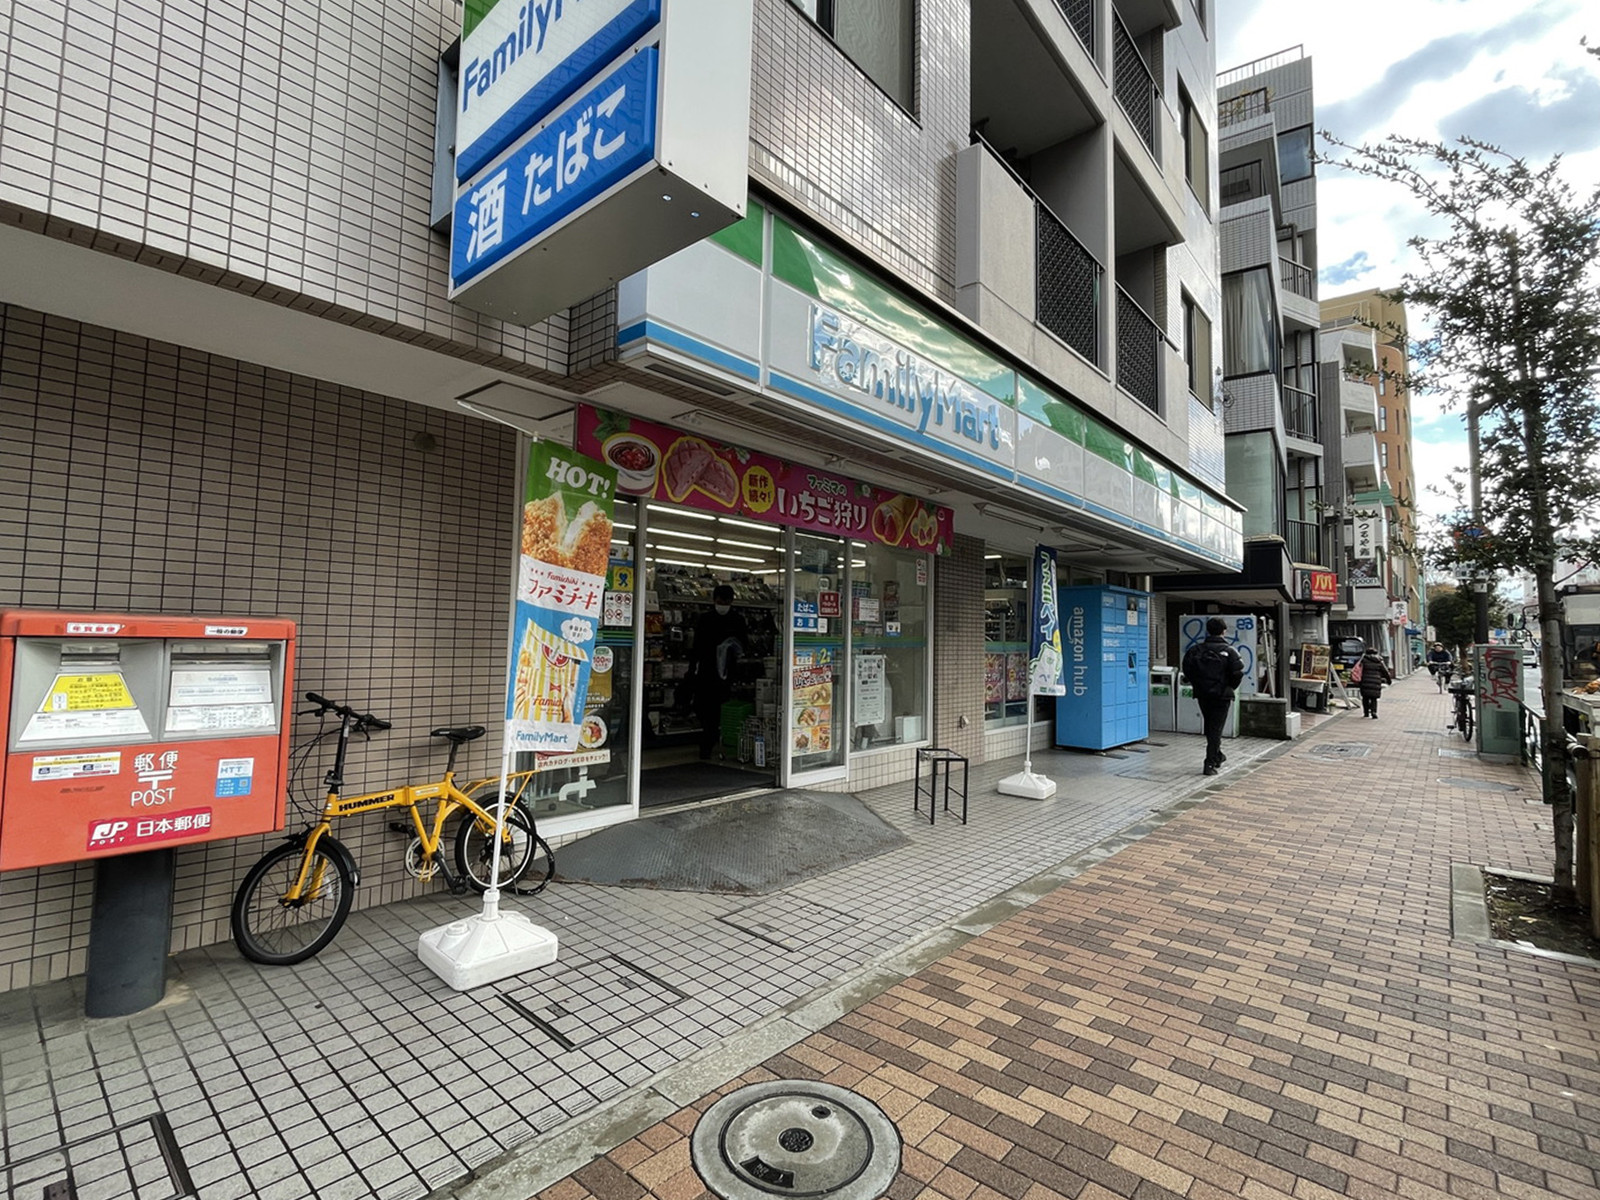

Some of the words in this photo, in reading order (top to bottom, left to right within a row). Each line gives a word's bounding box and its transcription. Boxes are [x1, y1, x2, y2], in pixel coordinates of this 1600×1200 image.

[466, 168, 508, 263] 酒
[521, 84, 626, 215] たばこ
[807, 301, 1001, 450] FamilyMart
[545, 457, 610, 499] HOT!
[749, 474, 768, 488] 新作
[807, 474, 847, 496] ファミマの
[777, 487, 867, 530] いちご狩り
[547, 571, 579, 585] Famichiki
[529, 578, 598, 610] ファミチキ
[797, 603, 815, 613] たばこ
[1073, 606, 1084, 662] amazon
[1073, 665, 1088, 696] hub
[516, 730, 569, 744] FamilyMart
[134, 750, 179, 774] 郵便
[131, 787, 177, 807] POST
[339, 794, 395, 812] HUMMER
[136, 812, 211, 837] 日本郵便
[89, 837, 125, 846] POST
